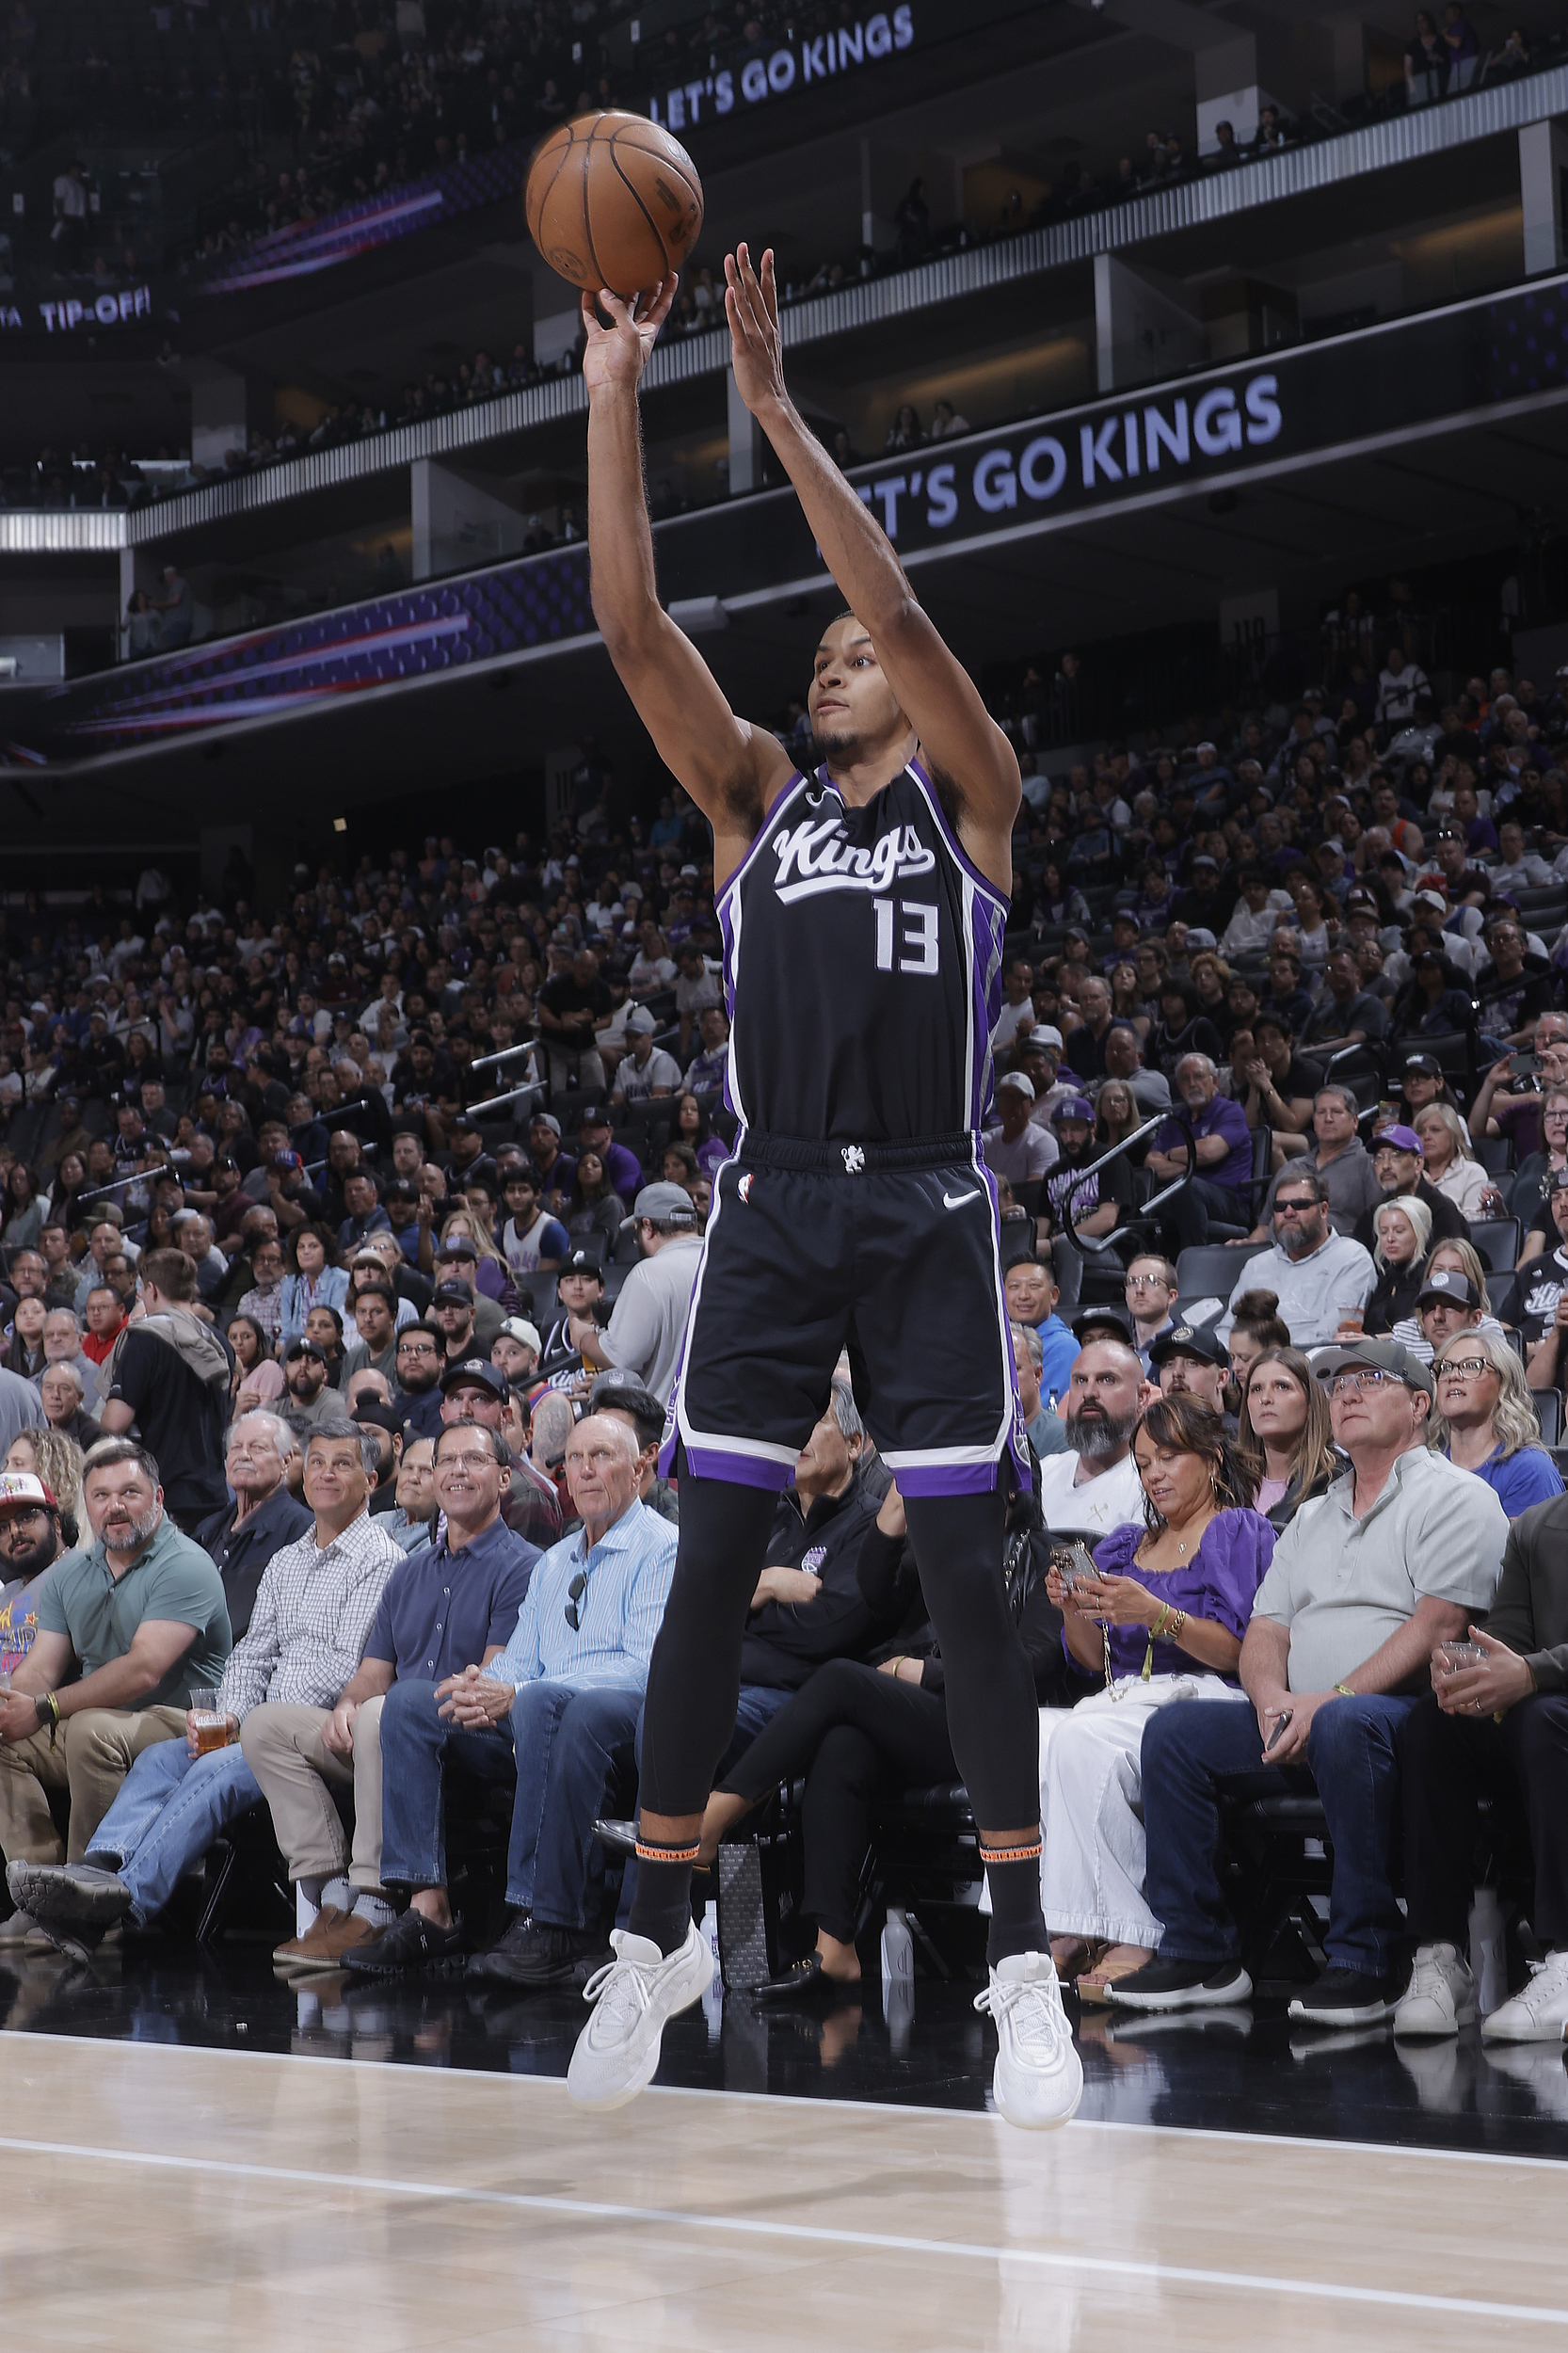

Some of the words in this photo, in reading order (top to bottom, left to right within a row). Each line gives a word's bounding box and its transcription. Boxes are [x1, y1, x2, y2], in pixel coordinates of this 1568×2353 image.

[649, 70, 735, 131] LET'S
[741, 49, 795, 103] GO
[802, 4, 914, 83] KINGS
[39, 284, 152, 333] TIP-OFF!
[851, 464, 959, 539] T'S
[972, 436, 1067, 513] GO
[1080, 374, 1283, 488] KINGS
[772, 818, 936, 906] Kings
[872, 896, 940, 976] 13
